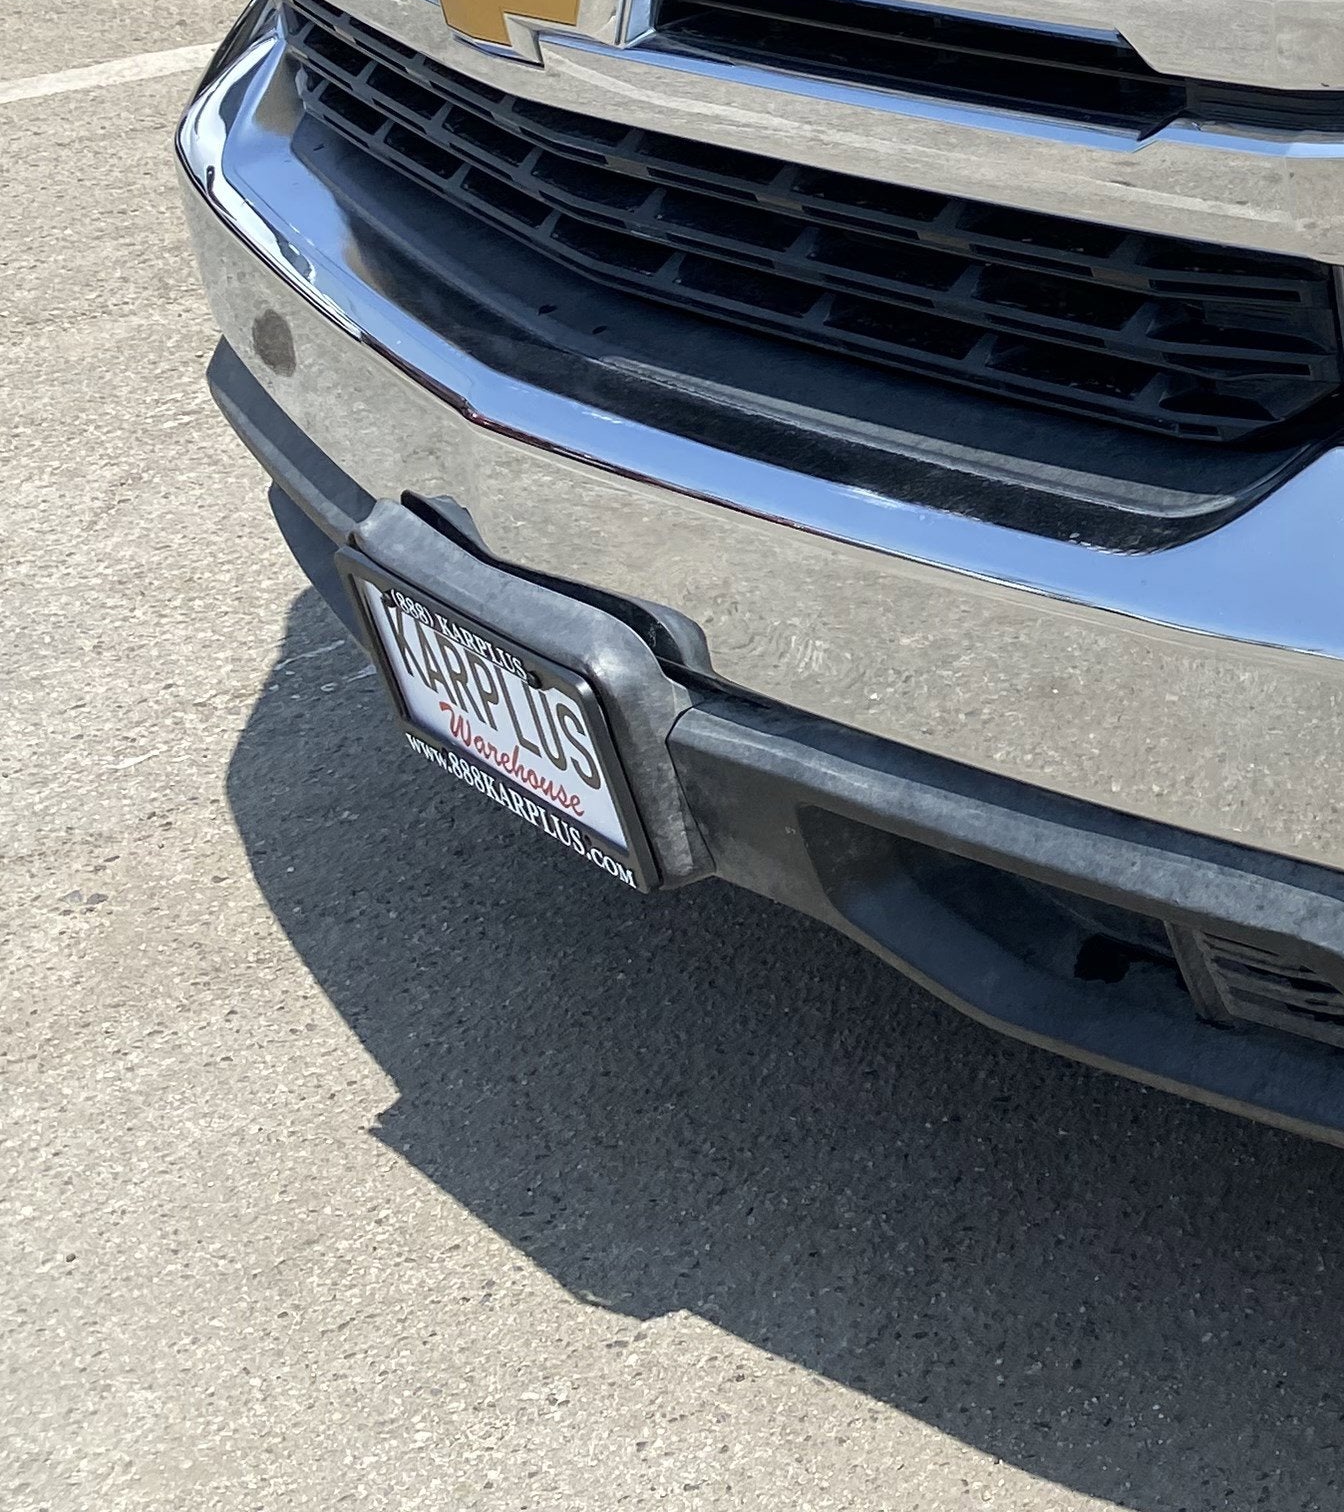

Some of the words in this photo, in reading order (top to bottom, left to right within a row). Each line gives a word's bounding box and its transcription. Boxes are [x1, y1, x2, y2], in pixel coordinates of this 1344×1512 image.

[390, 589, 435, 627] (888)
[435, 613, 528, 682] KARPLUS
[384, 602, 601, 790] KARPLUS
[438, 701, 585, 817] Warehouse
